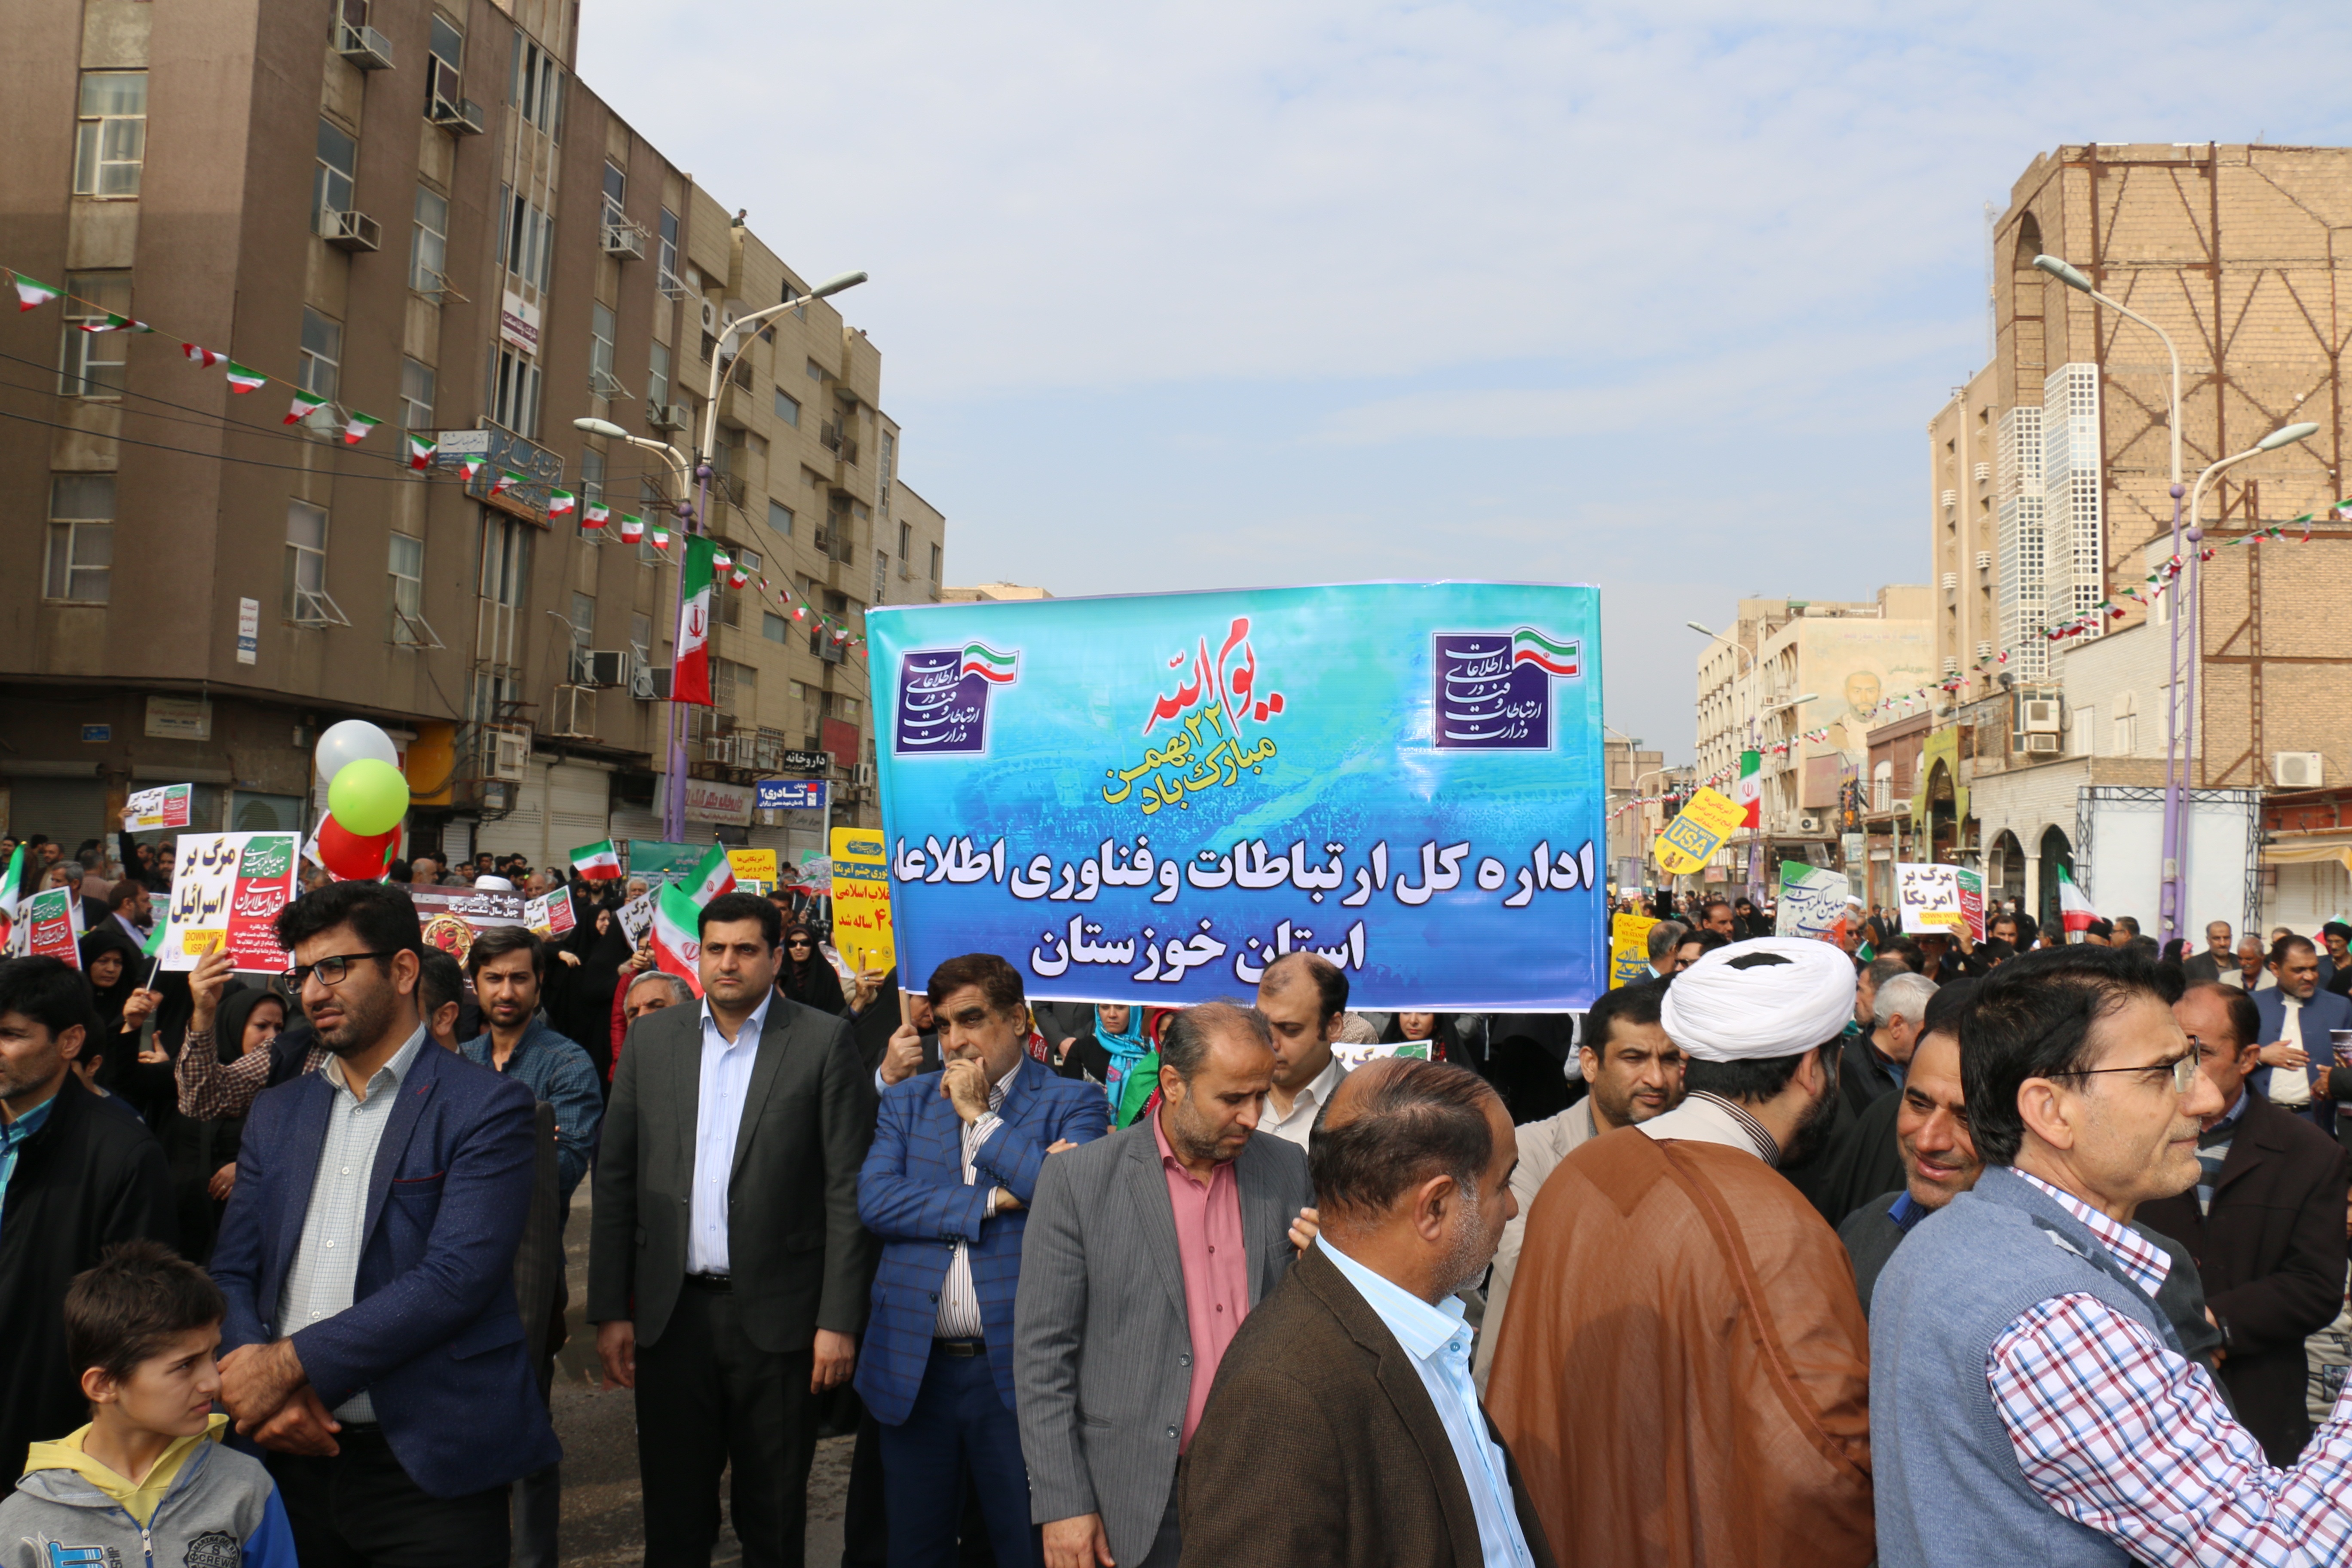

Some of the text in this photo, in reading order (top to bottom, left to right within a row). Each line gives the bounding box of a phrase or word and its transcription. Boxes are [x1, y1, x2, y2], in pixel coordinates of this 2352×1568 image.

[786, 752, 825, 768] داروخانه
[1102, 732, 1195, 804] بهمن
[1140, 773, 1190, 815] باد
[129, 801, 159, 816] امریک
[1680, 818, 1716, 843] DOWN WITH
[1669, 824, 1708, 857] USA
[180, 837, 236, 877] مرگ بر
[894, 835, 1006, 883] اطلاعا
[833, 863, 854, 876] آمریکا
[854, 865, 871, 879] چشم
[1187, 839, 1388, 906] ارتباطات
[1395, 840, 1470, 906] کل
[1476, 839, 1596, 907] اداره
[1920, 866, 1952, 886] مرگ
[1902, 870, 1915, 886] بر
[489, 894, 503, 904] سال
[835, 883, 868, 900] اسلامی
[1903, 889, 1954, 910] امریکا
[171, 883, 227, 925] اسرائیل
[504, 895, 519, 906] چهل
[468, 906, 488, 914] شکست
[489, 906, 503, 916] سال
[503, 907, 519, 918] چهل
[838, 913, 852, 927] شد
[853, 914, 873, 929] ساله
[185, 931, 205, 941] DOWN
[1031, 914, 1228, 982] خوزستان
[193, 1536, 219, 1552] MARINA
[219, 1537, 231, 1548] DEL
[199, 1554, 231, 1568] CREW
